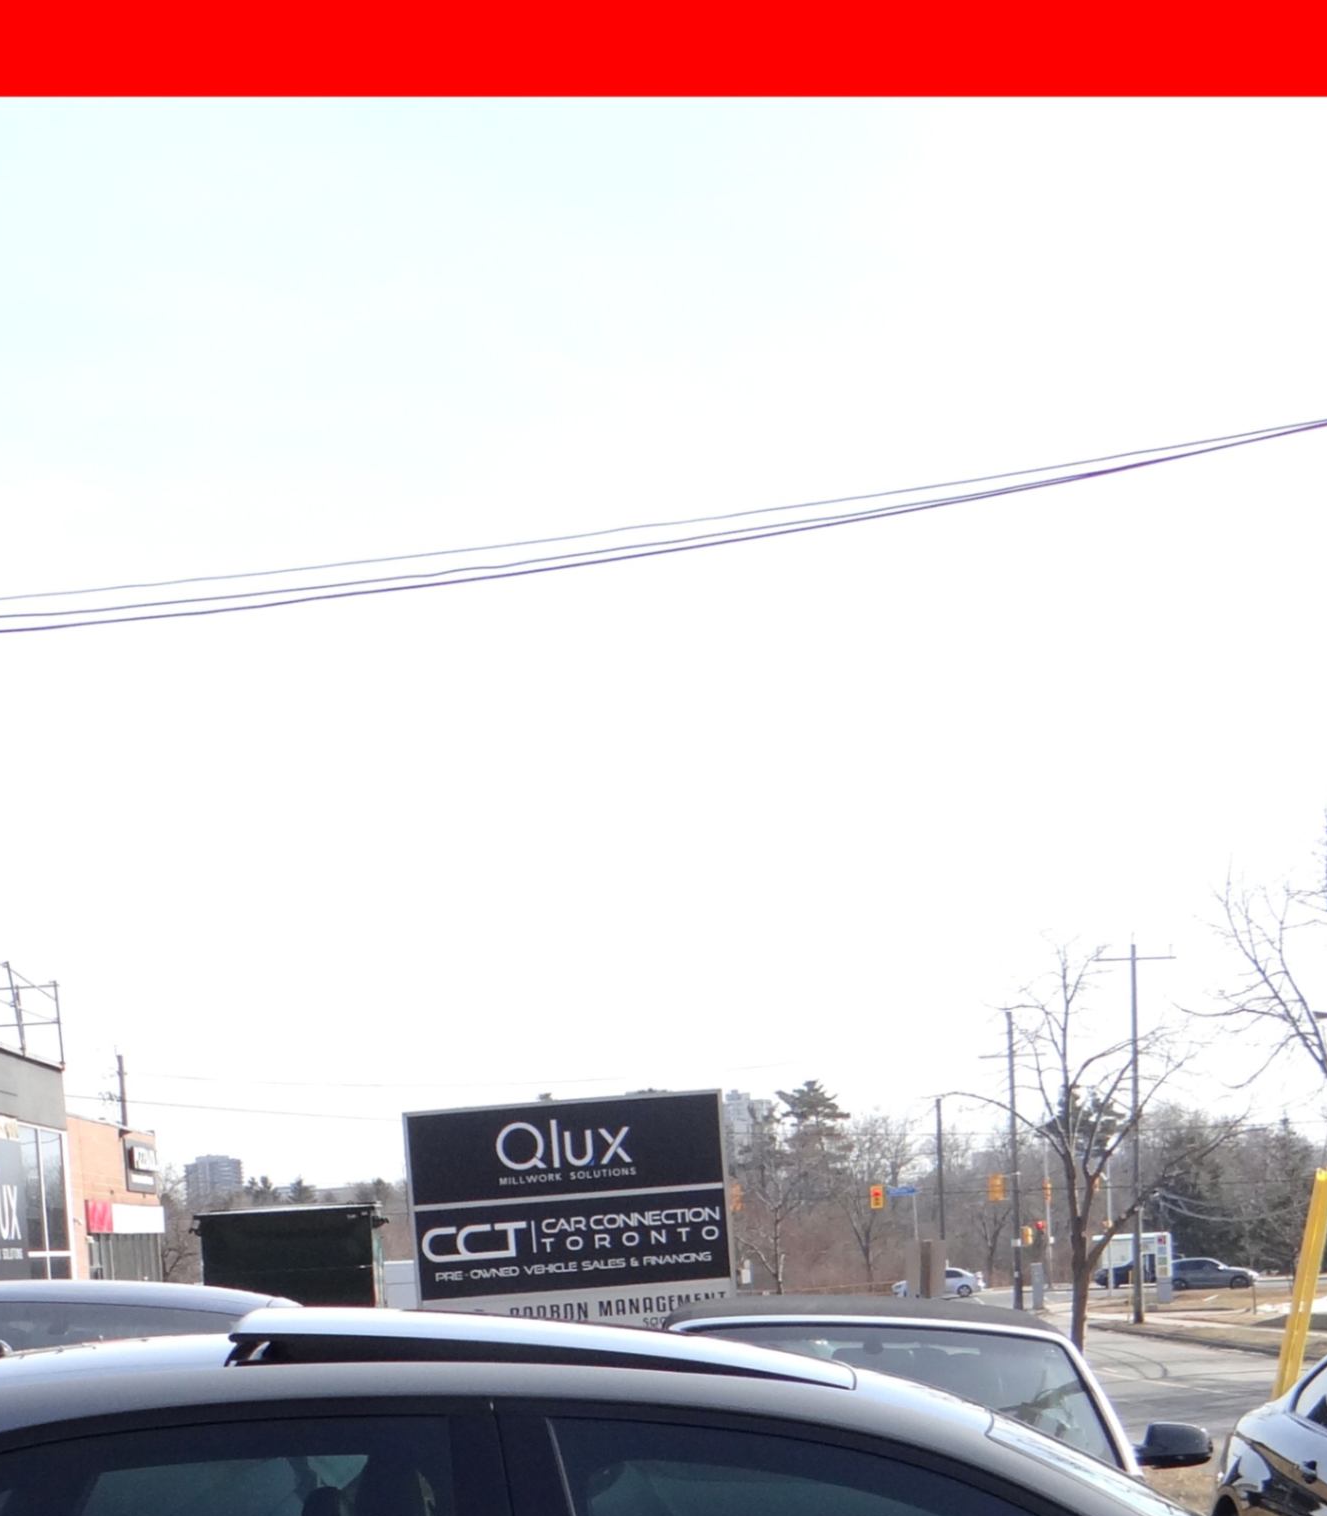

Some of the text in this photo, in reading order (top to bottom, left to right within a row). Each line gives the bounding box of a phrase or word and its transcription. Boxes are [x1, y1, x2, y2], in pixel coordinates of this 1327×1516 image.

[496, 1119, 632, 1170] Qlux
[499, 1166, 637, 1186] MILLWORK SOLUTIONS
[541, 1206, 721, 1234] CAR CONNECTION
[422, 1221, 527, 1263] CCT
[541, 1226, 720, 1253] TORONTO
[523, 1260, 578, 1275] VEHICLE
[581, 1258, 626, 1271] SALES
[630, 1257, 640, 1268] &
[642, 1251, 713, 1267] FINANCING
